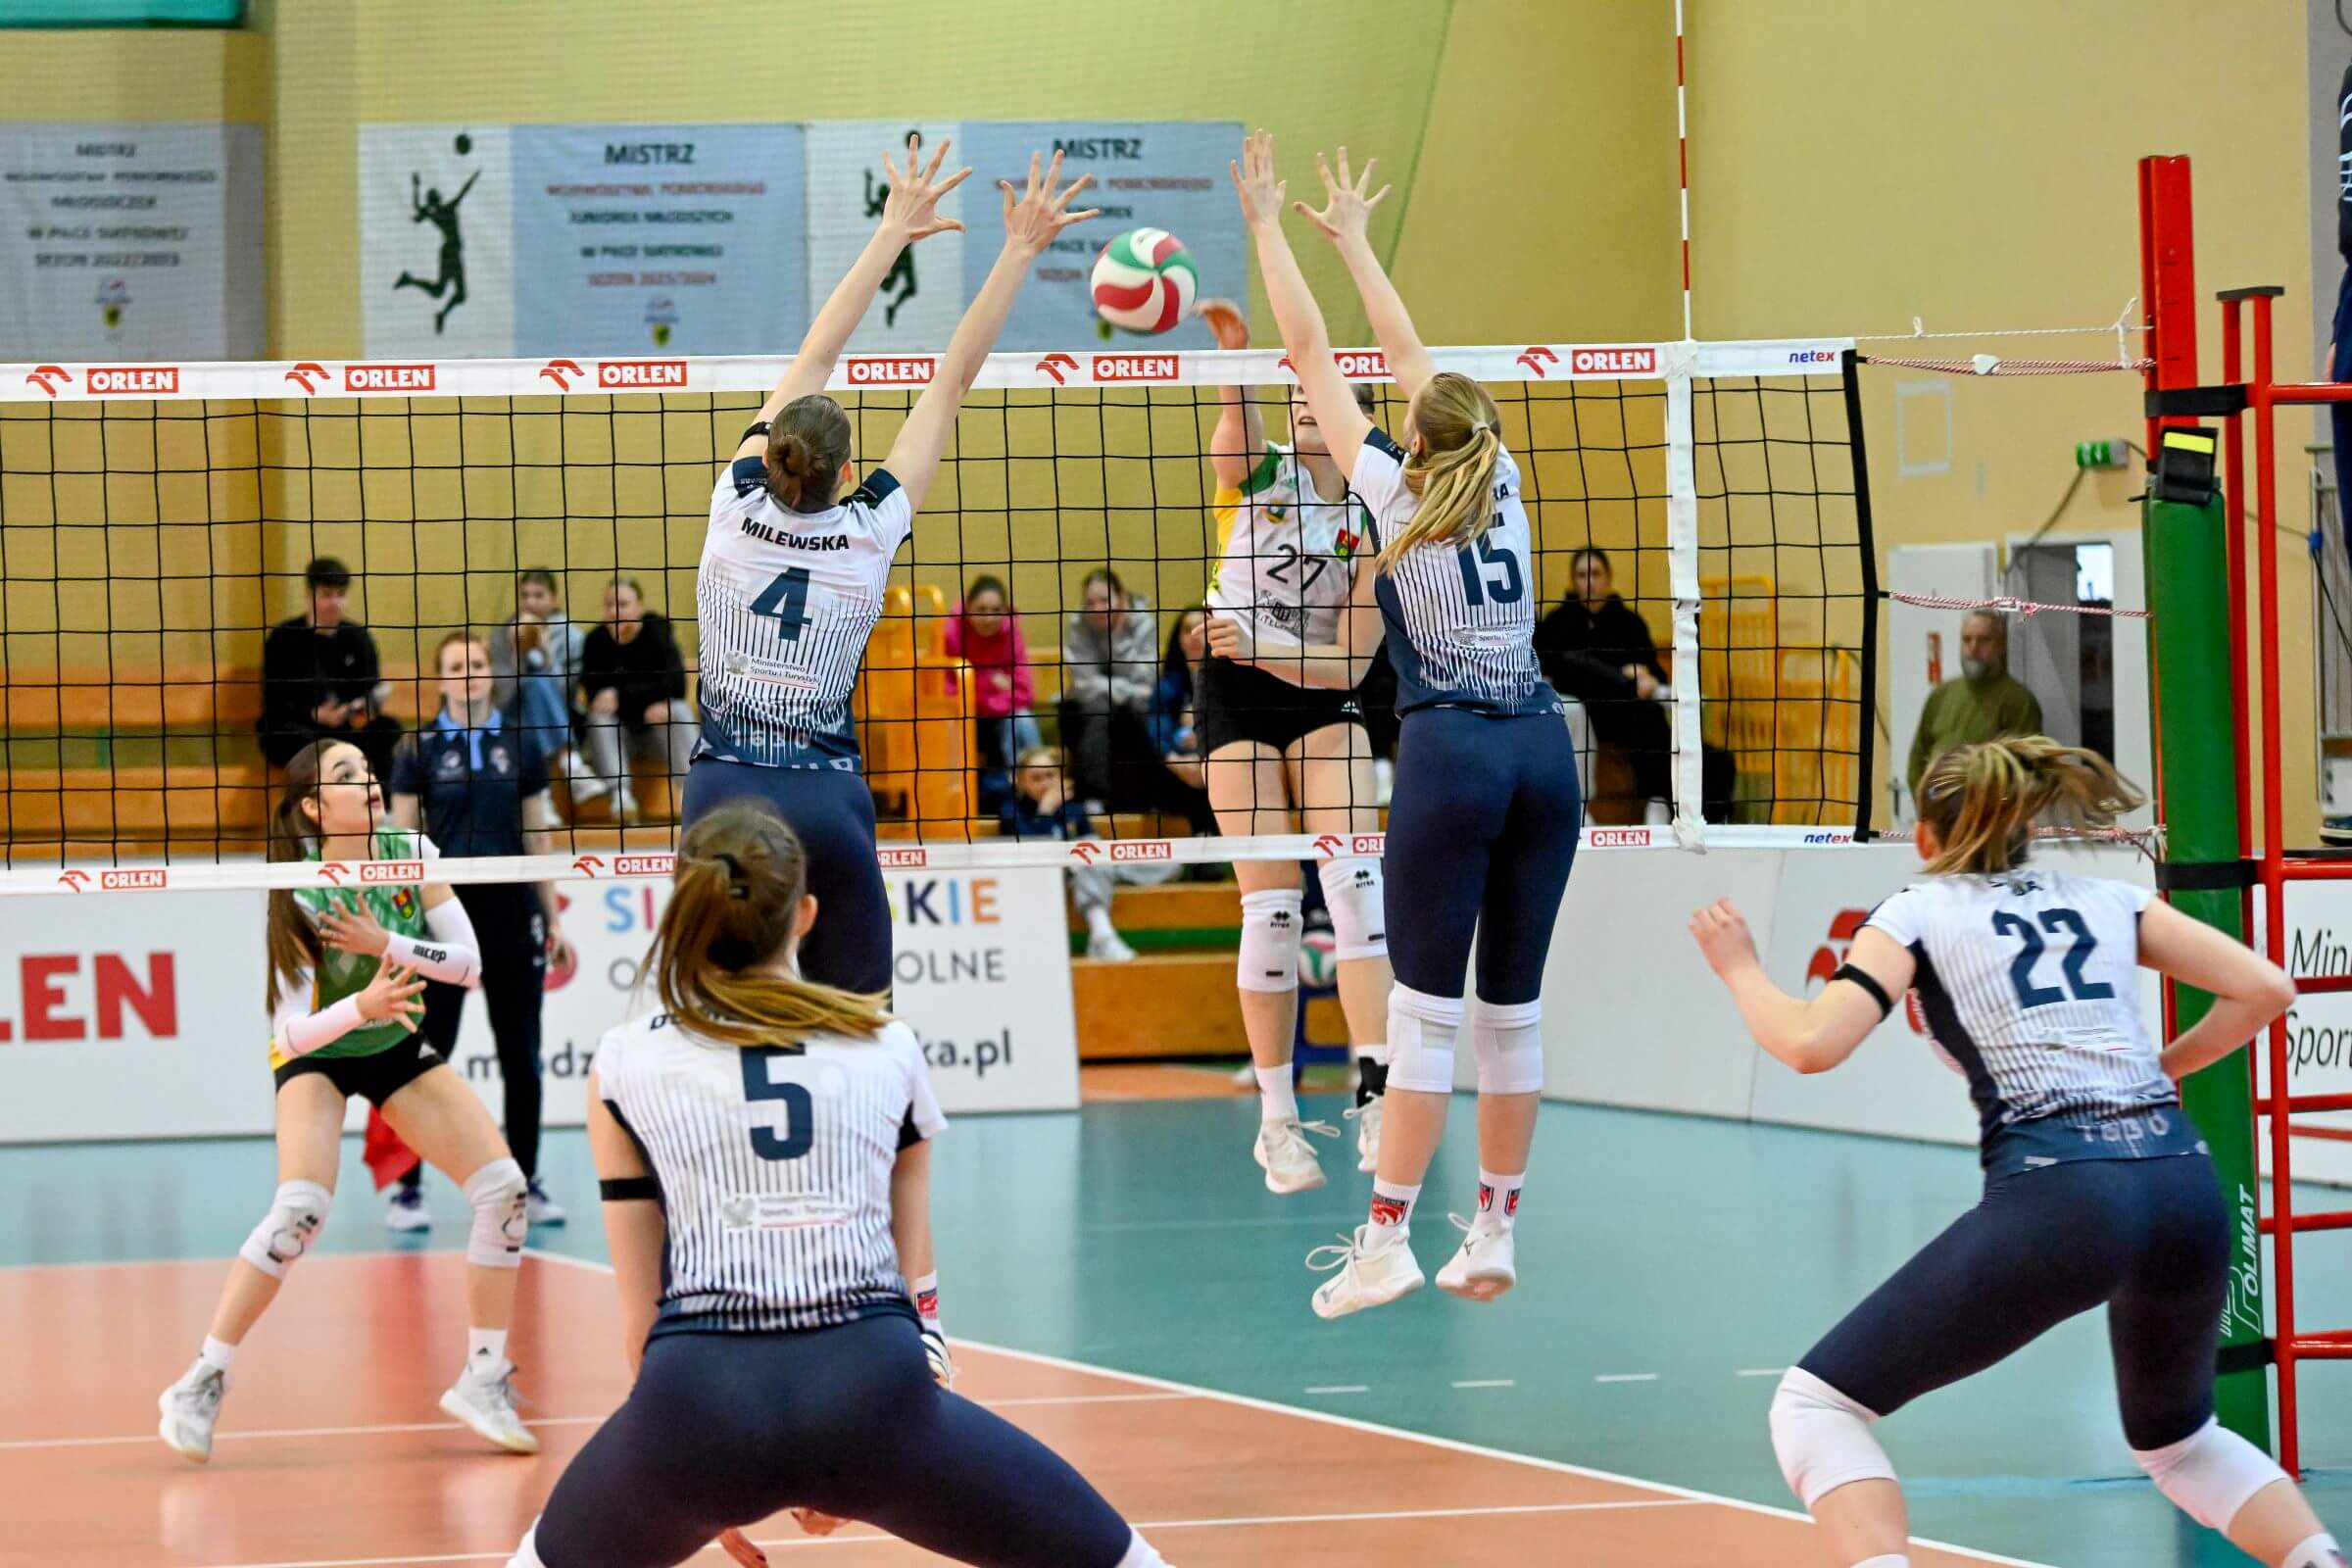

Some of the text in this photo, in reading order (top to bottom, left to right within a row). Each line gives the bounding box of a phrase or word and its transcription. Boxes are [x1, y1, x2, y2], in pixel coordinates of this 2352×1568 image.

[605, 144, 695, 165] MISTRZ
[1054, 139, 1143, 159] MISTRZ
[1338, 356, 1391, 375] ORL
[1574, 351, 1652, 372] ORLEN
[1788, 350, 1835, 363] netex
[348, 367, 432, 390] ORLEN
[601, 363, 684, 387] ORLEN
[851, 361, 932, 383] ORLEN
[1096, 357, 1176, 380] ORLEN
[90, 369, 175, 392] ORLEN
[741, 516, 850, 551] MILEWSKA
[1266, 544, 1328, 591] 27
[1457, 513, 1525, 607] 15
[750, 565, 812, 642] 4
[751, 658, 806, 672] Ministerstwo
[751, 666, 777, 676] Sportu
[1592, 830, 1647, 847] ORLEN
[1804, 832, 1851, 844] netex
[877, 851, 923, 866] RLEN
[1112, 844, 1169, 858] ORLEN
[362, 864, 422, 880] ORLEN
[616, 858, 674, 873] ORLEN
[103, 871, 165, 889] ORLEN
[1991, 907, 2117, 1009] 22
[2290, 927, 2352, 978] Min
[894, 950, 1006, 984] OLNE
[0, 953, 178, 1042] EN
[740, 1042, 814, 1161] 5
